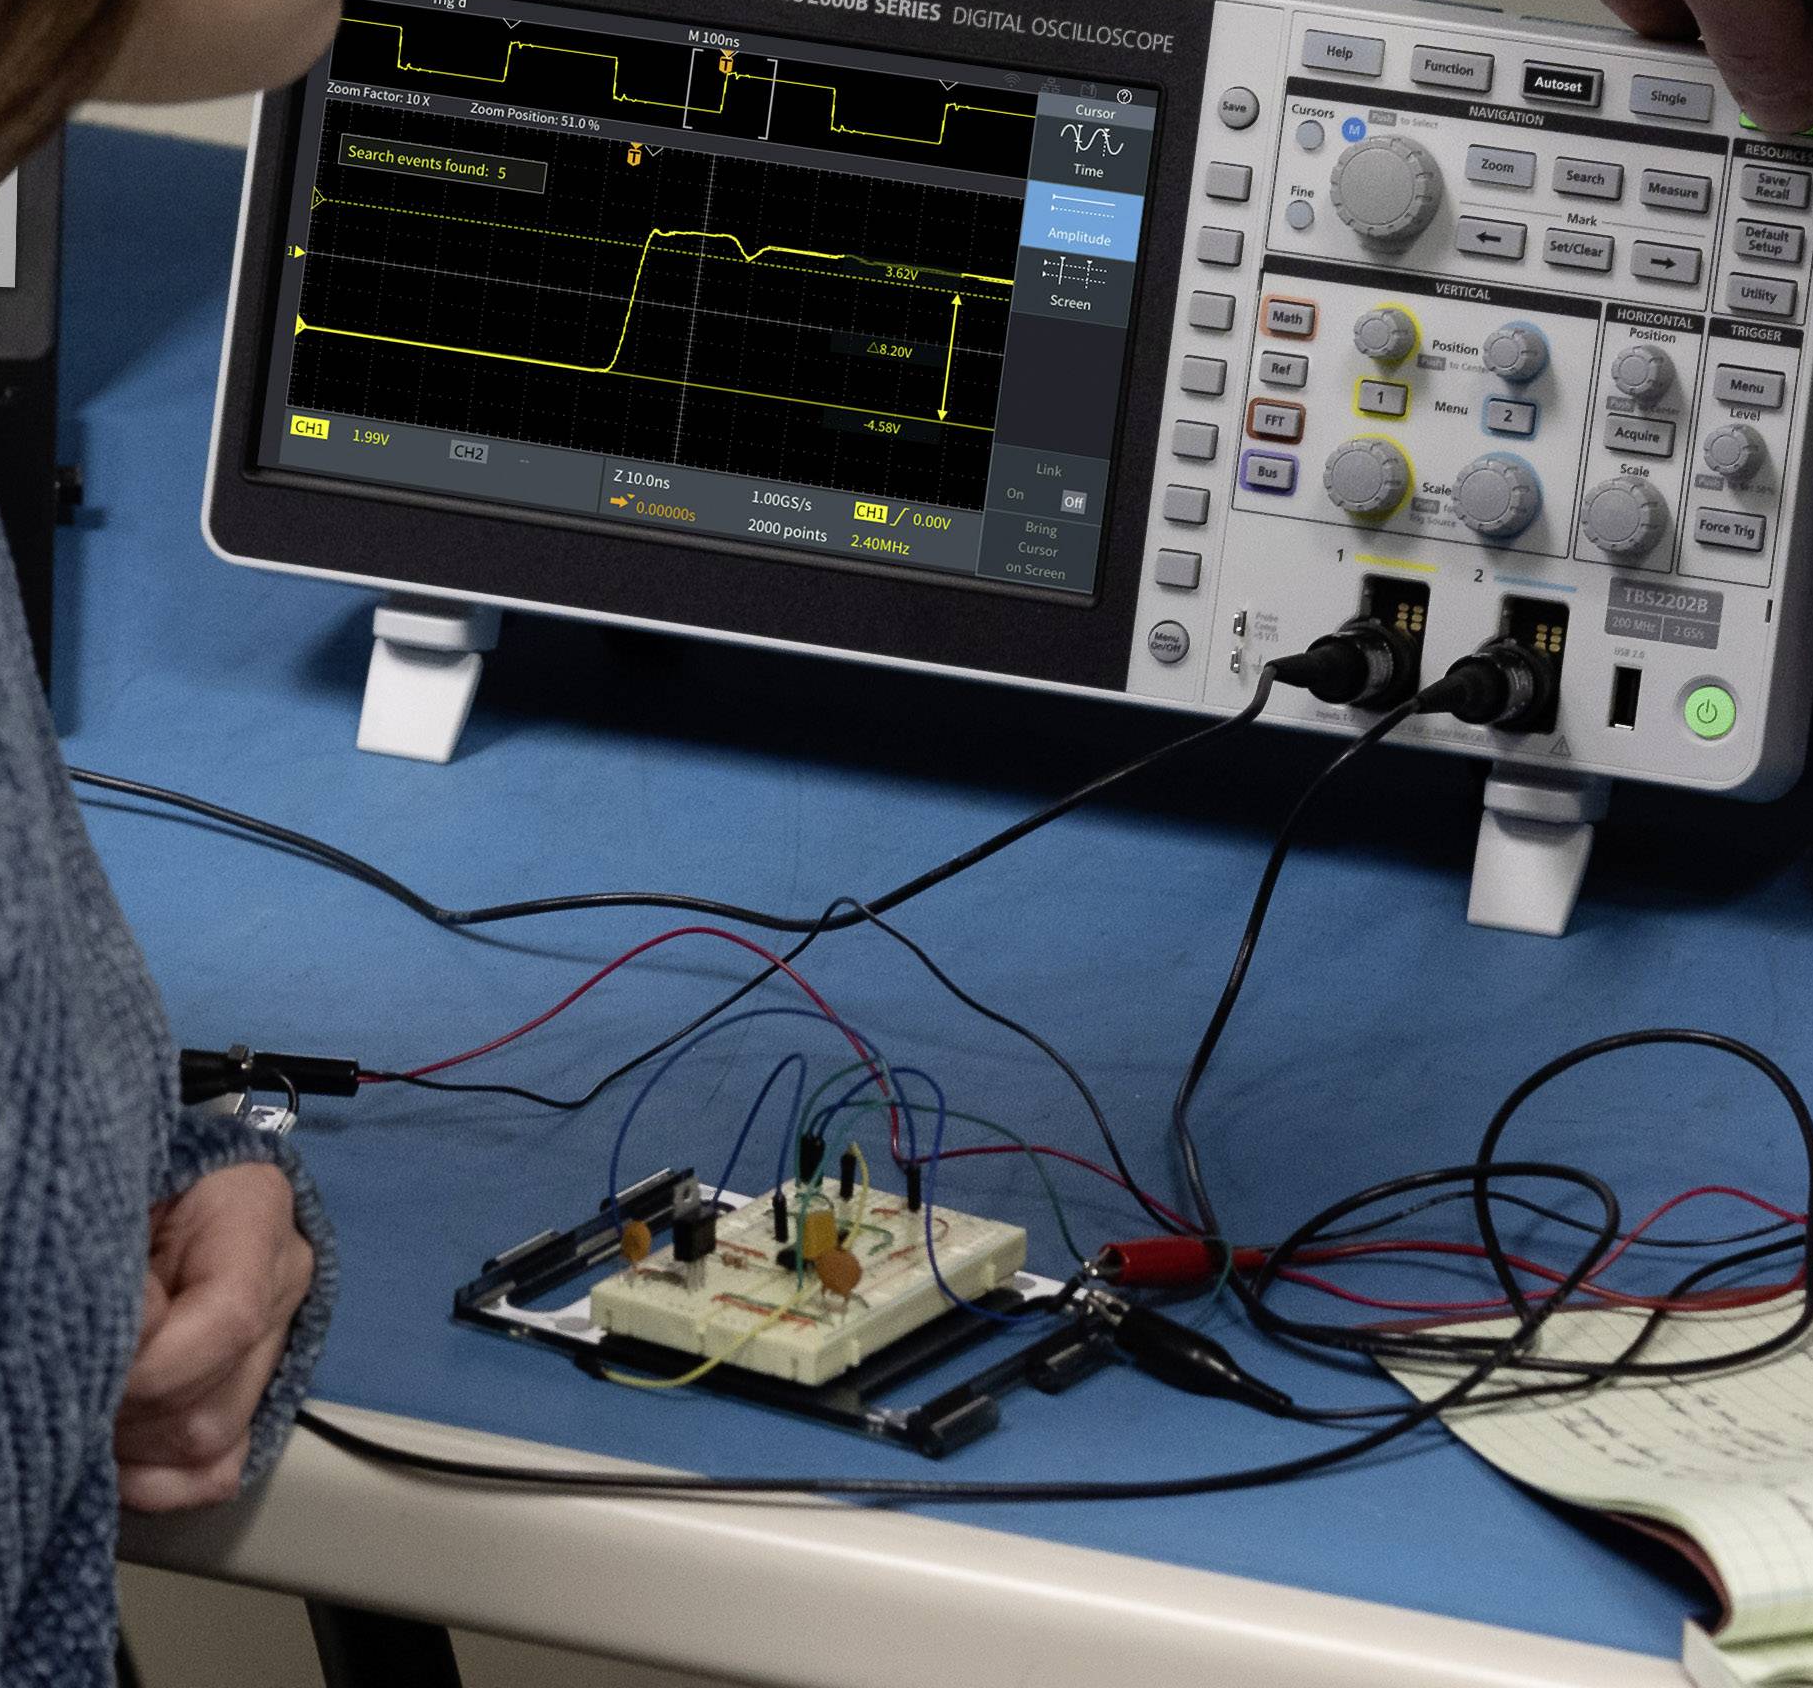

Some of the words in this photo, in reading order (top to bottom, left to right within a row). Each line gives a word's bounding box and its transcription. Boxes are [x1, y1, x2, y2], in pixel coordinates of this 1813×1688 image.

[688, 30, 699, 42] M
[702, 31, 740, 48] 100ns
[953, 6, 1027, 34] DIGITAL
[1032, 16, 1175, 54] OSCILLOSCOPE
[1327, 44, 1353, 60] Help
[1424, 59, 1474, 77] Function
[1535, 76, 1583, 94] Autoset
[327, 82, 352, 96] Zoom
[353, 85, 405, 104] Factor:
[406, 93, 420, 105] 10
[422, 96, 431, 107] X
[1651, 90, 1687, 107] Single
[1075, 104, 1116, 120] Cursor
[1222, 101, 1247, 112] Save
[1291, 103, 1335, 119] Cursors
[1469, 105, 1544, 126] NAVIGATION
[470, 102, 496, 116] Zoom
[498, 106, 559, 126] Position:
[561, 114, 586, 130] 51.0
[588, 118, 601, 131] %
[348, 144, 395, 164] Search
[397, 153, 442, 171] events
[445, 156, 489, 178] found:
[497, 166, 507, 180] 5
[1073, 162, 1104, 179] Time
[1481, 157, 1514, 174] Zoom
[1566, 169, 1605, 186] Search
[1759, 172, 1791, 187] Save/
[1291, 185, 1315, 199] Fine
[1648, 182, 1699, 200] Measure
[1755, 185, 1790, 201] Recall
[1567, 212, 1598, 227] Mark
[1047, 226, 1112, 248] Amplitude
[1745, 226, 1789, 244] Default
[1549, 240, 1604, 258] Set/Clear
[1748, 239, 1783, 256] Setup
[885, 266, 919, 281] 3.62V
[1436, 282, 1491, 300] VERTICAL
[1741, 286, 1777, 304] Utility
[1050, 294, 1091, 311] Screen
[1273, 310, 1303, 325] Math
[1617, 309, 1694, 330] HORIZONTAL
[1731, 324, 1783, 342] TRIGGER
[1432, 339, 1479, 356] Position
[1730, 379, 1765, 394] Menu
[295, 420, 324, 436] CH1
[353, 429, 390, 447] 1.99V
[863, 418, 901, 435] -4.58V
[1615, 427, 1660, 444] Acquire
[454, 445, 484, 462] CH2
[1037, 462, 1063, 478] Link
[614, 470, 624, 484] Z
[627, 471, 671, 490] 10.0ns
[752, 490, 813, 512] 1.00GS/s
[1006, 487, 1025, 501] On
[1063, 494, 1083, 509] Off
[636, 500, 696, 522] 0.00000s
[856, 504, 886, 522] CH1
[913, 512, 951, 531] 0.00V
[748, 518, 780, 538] 2000
[783, 523, 828, 544] points
[1025, 522, 1058, 540] Bring
[1699, 519, 1730, 534] Force
[1734, 524, 1755, 540] Trig
[851, 534, 910, 556] 2.40MHz
[1018, 542, 1059, 558] Cursor
[1005, 563, 1021, 574] on
[1024, 564, 1066, 581] Screen
[1623, 587, 1709, 613] TBS2202B
